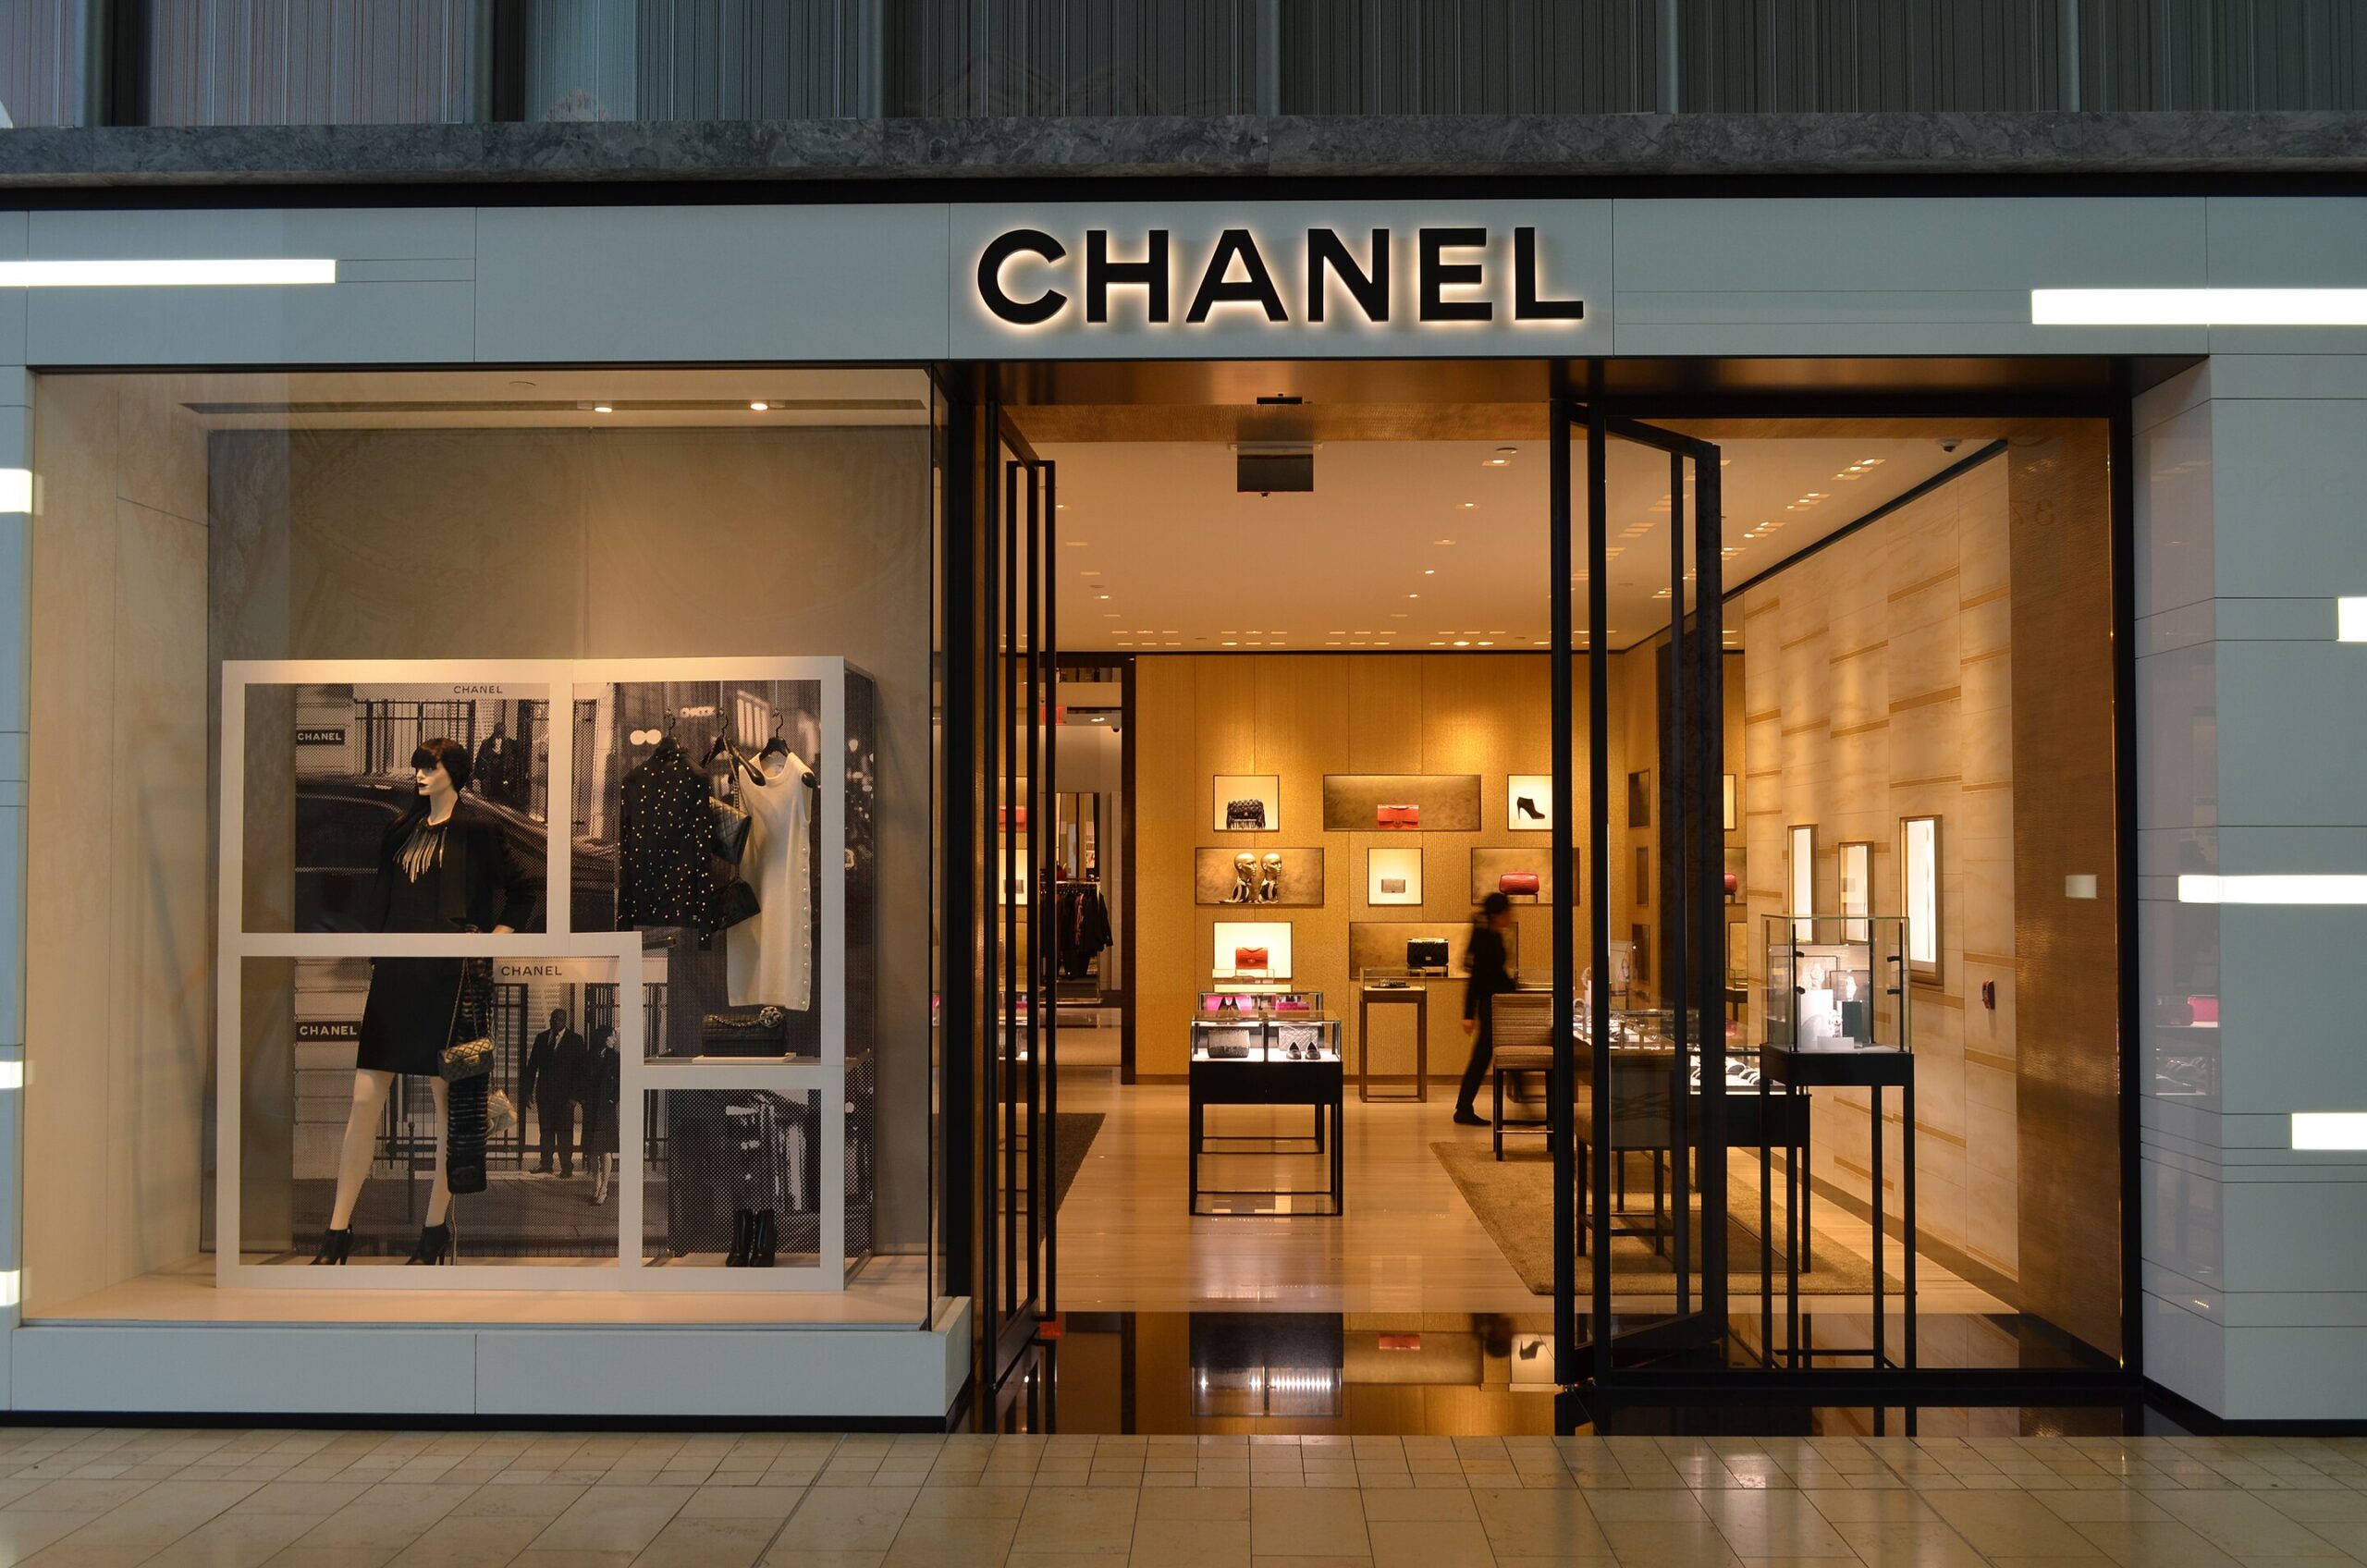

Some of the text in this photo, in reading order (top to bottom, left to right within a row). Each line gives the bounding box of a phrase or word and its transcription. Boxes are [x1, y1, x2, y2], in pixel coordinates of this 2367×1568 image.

[977, 227, 1584, 325] CHANEL
[453, 684, 503, 694] CHANEL
[297, 732, 342, 741] CHANEL
[501, 965, 563, 976] CHANEL
[299, 1025, 358, 1035] CHANEL
